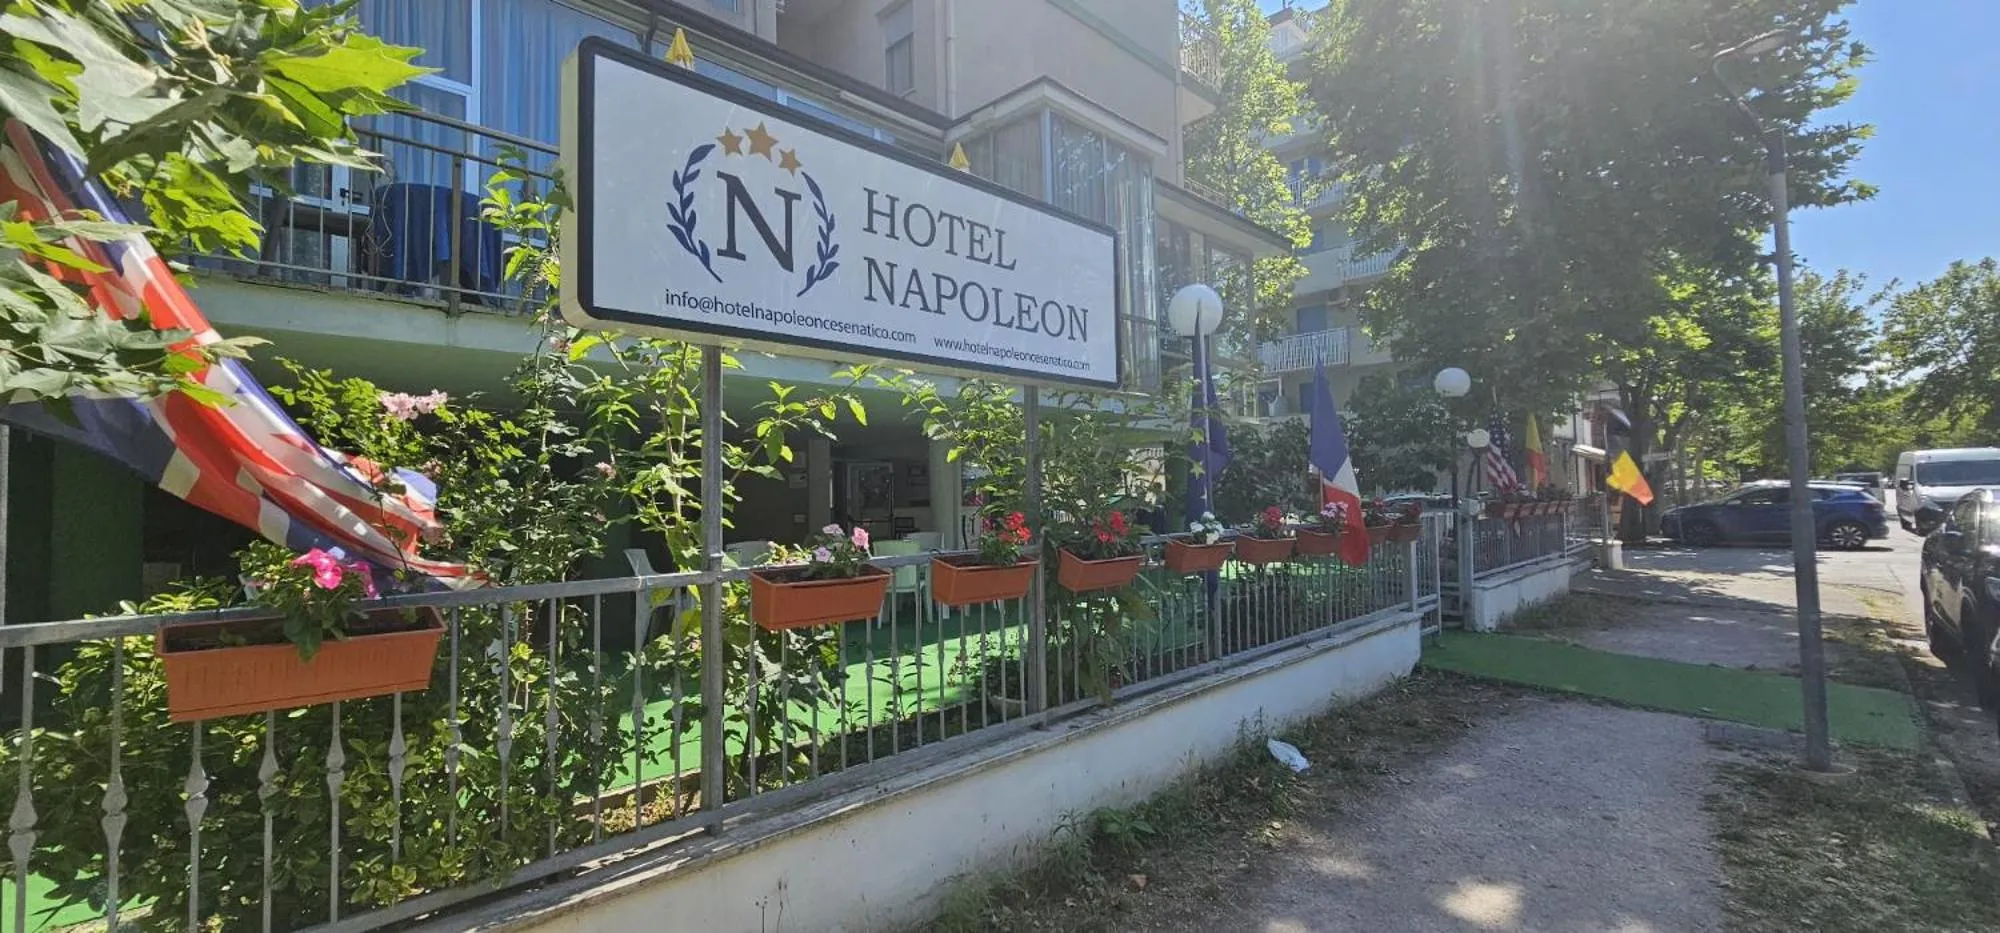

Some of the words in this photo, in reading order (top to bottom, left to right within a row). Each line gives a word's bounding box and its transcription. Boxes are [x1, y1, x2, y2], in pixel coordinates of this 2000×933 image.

[717, 170, 802, 273] N
[863, 187, 1016, 270] HOTEL
[665, 289, 917, 344] info@hotelnapoleoncesenatico.com
[863, 257, 1089, 343] NAPOLEON
[933, 336, 1091, 371] www.hotelnapoleoncesenatico.com
